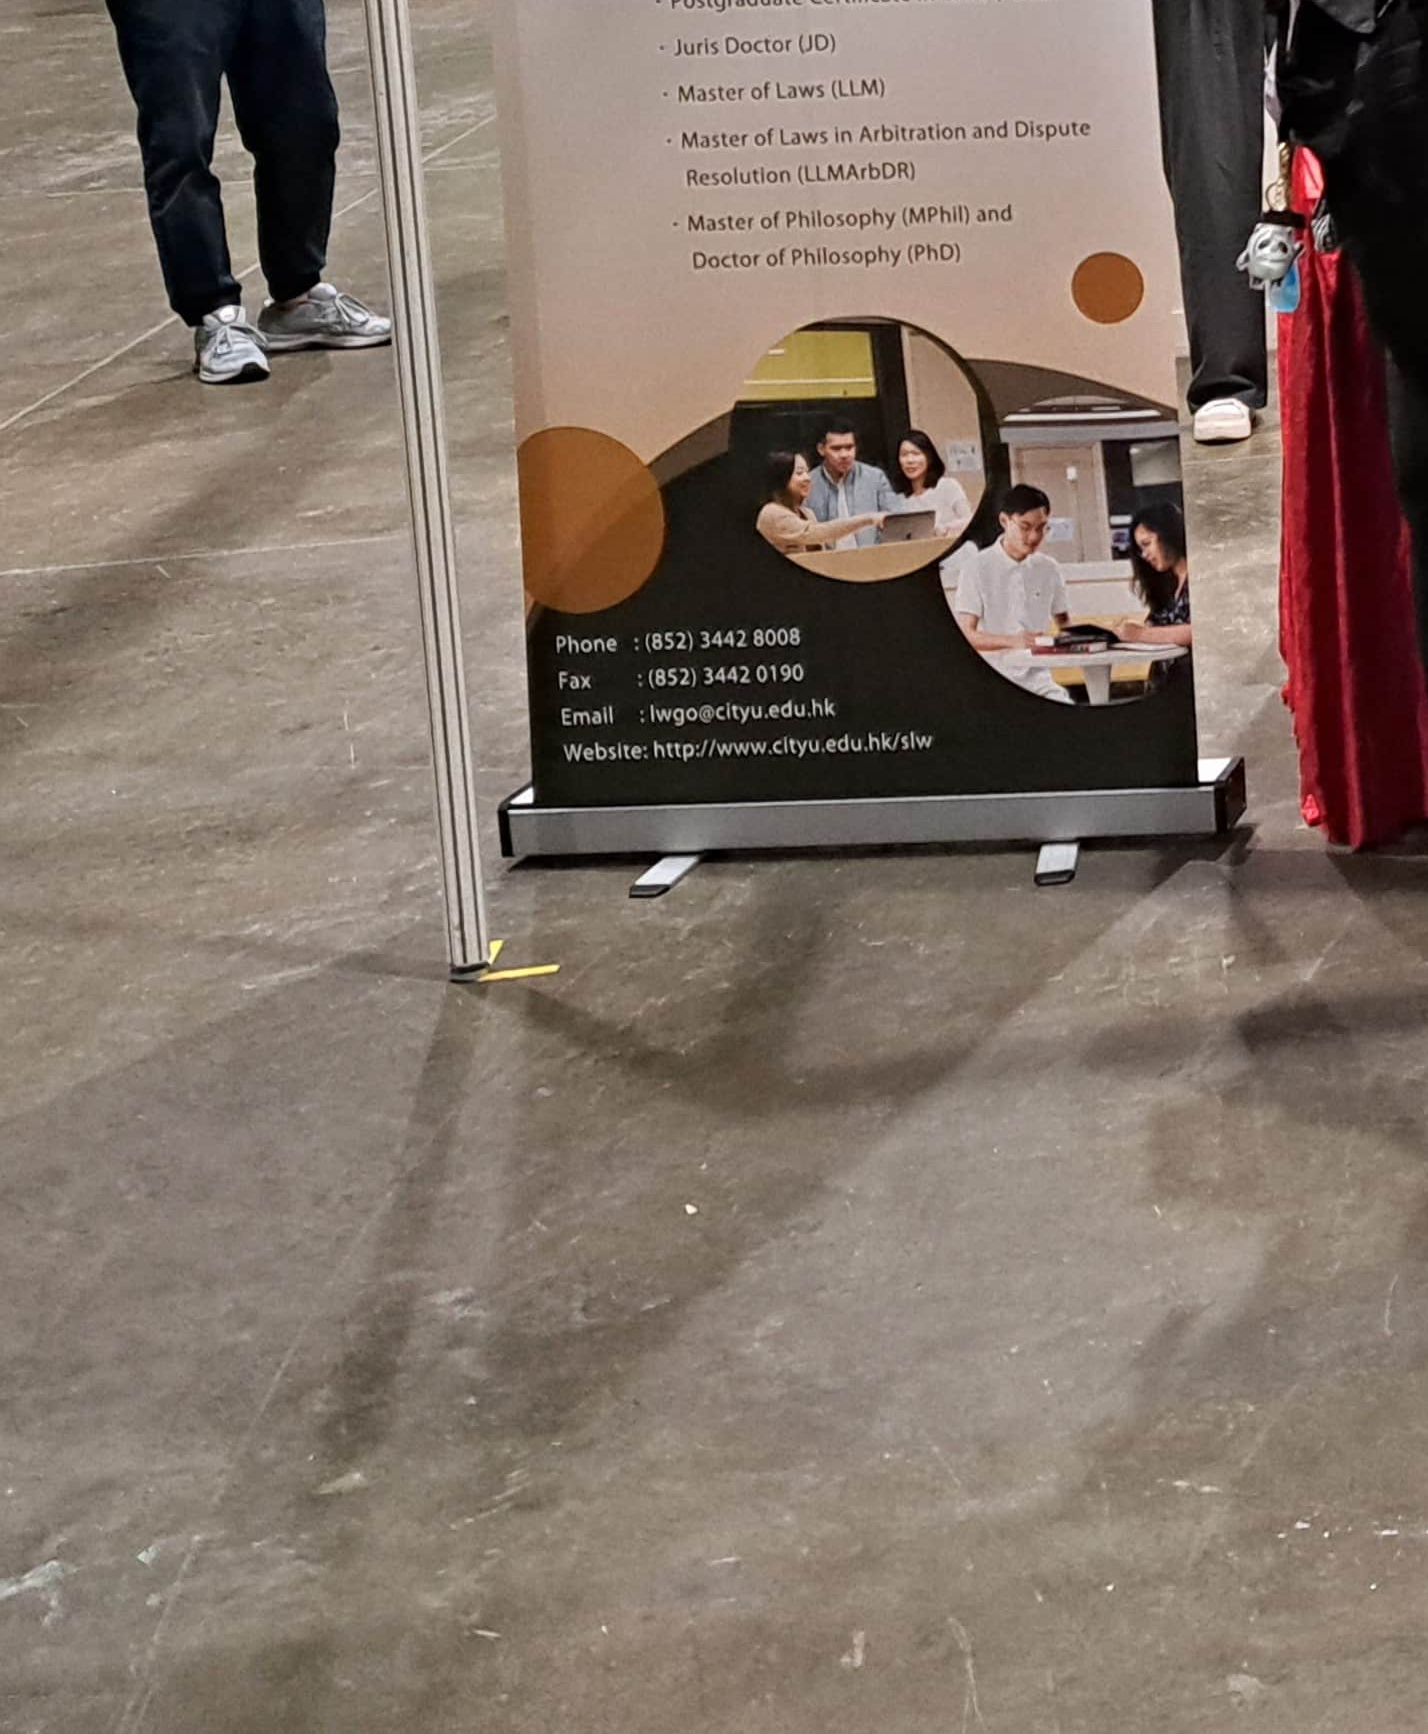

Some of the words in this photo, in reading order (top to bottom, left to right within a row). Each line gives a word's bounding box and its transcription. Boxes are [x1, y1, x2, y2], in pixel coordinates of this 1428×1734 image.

[679, 85, 744, 102] Master
[751, 82, 770, 100] of
[776, 82, 824, 99] Laws
[832, 79, 884, 99] (LLM)
[682, 132, 748, 148] Master
[755, 128, 774, 146] of
[780, 129, 828, 145] Laws
[835, 127, 852, 143] in
[860, 123, 966, 142] Arbitration
[973, 121, 1008, 139] and
[1015, 121, 1090, 141] Dispute
[687, 167, 791, 186] Resolution
[798, 162, 915, 185] (LLMArbDR)
[688, 215, 753, 231] Master
[761, 211, 780, 229] of
[786, 208, 896, 230] Philosophy
[903, 205, 969, 226] (MPhil)
[977, 204, 1012, 222] and
[557, 635, 617, 653] Phone
[646, 631, 693, 652] (852)
[701, 630, 747, 648] 3442
[754, 628, 800, 646] 8008
[559, 671, 591, 689] Fax
[649, 668, 696, 688] (852)
[704, 666, 750, 684] 3442
[757, 664, 804, 682] 0190
[562, 706, 613, 725] Email
[650, 698, 835, 726] lwgo@cityu.edu.hk
[564, 742, 648, 761] Website:
[654, 731, 932, 762] http://www.cityu.edu.hk/slw
